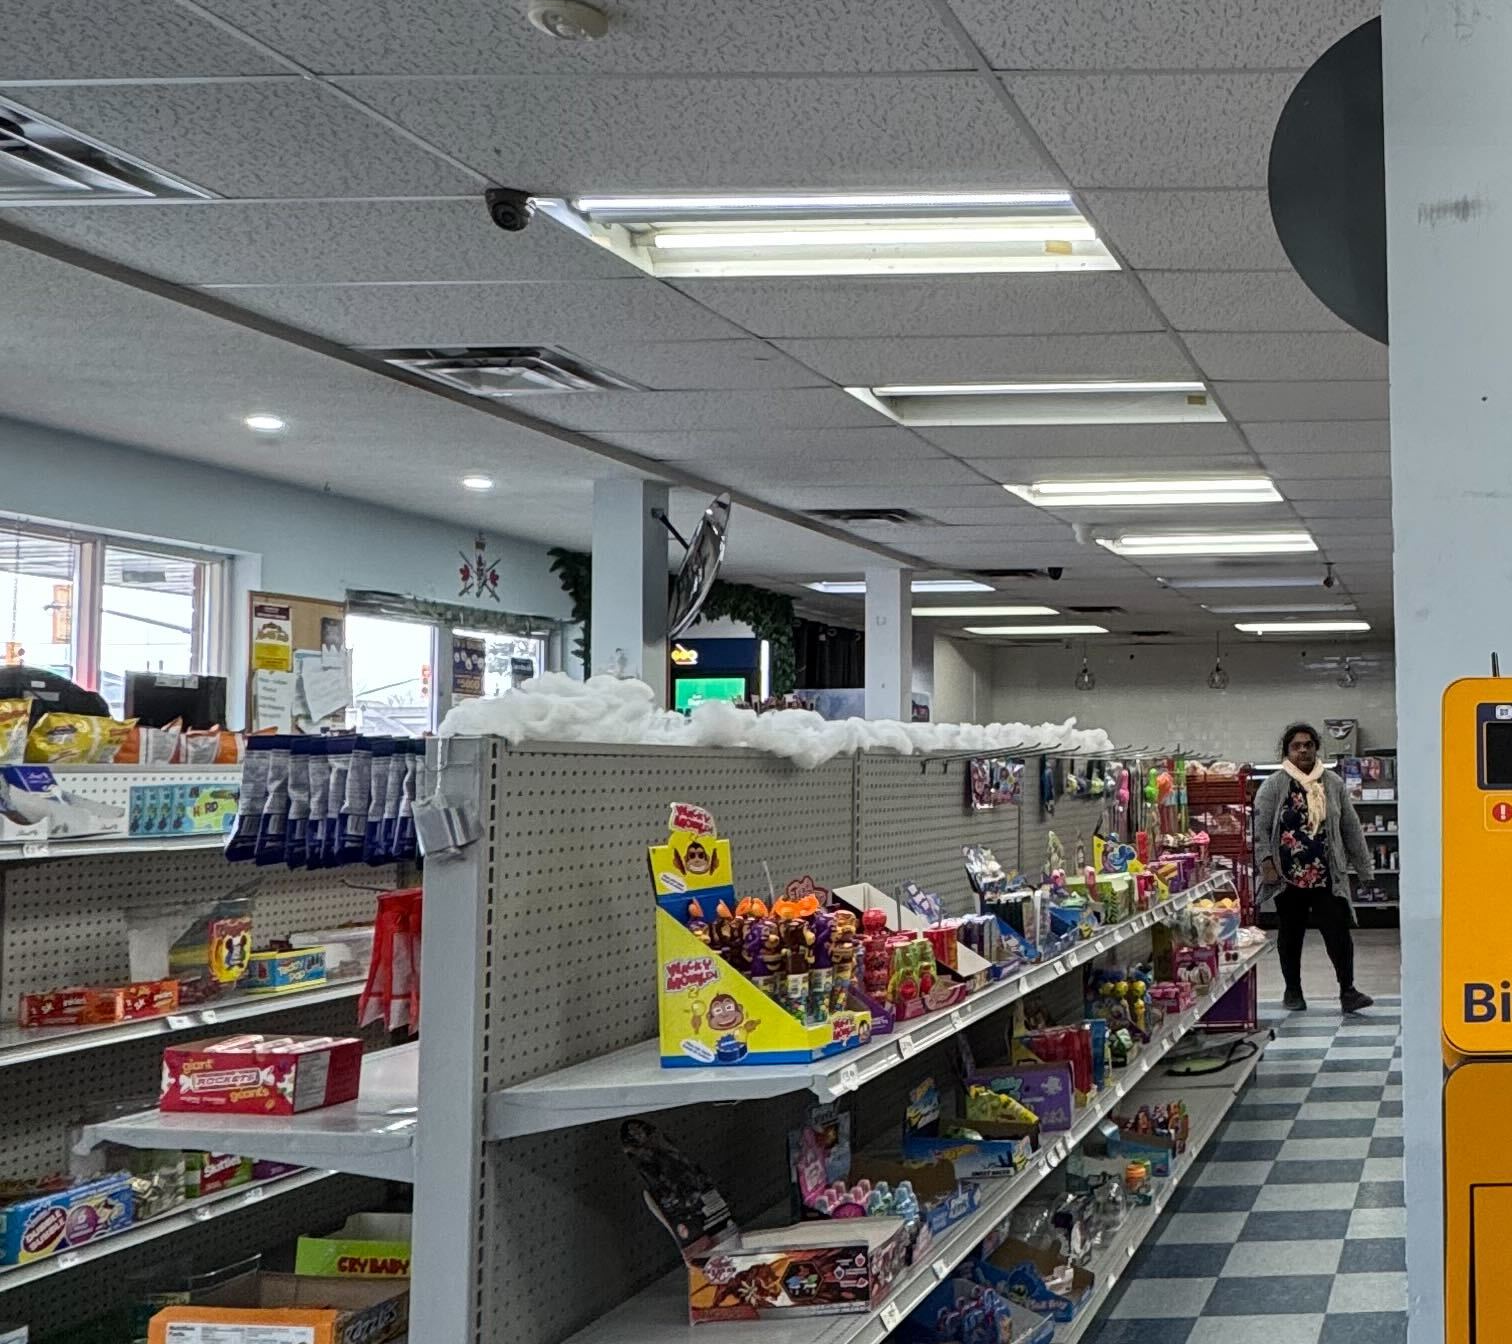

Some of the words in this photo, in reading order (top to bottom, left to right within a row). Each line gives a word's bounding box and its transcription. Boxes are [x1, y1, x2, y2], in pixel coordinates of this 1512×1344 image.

[667, 958, 712, 977] WACKY
[196, 1074, 256, 1086] ROCKETS
[338, 1256, 367, 1273] CRY
[369, 1256, 410, 1275] BABY
